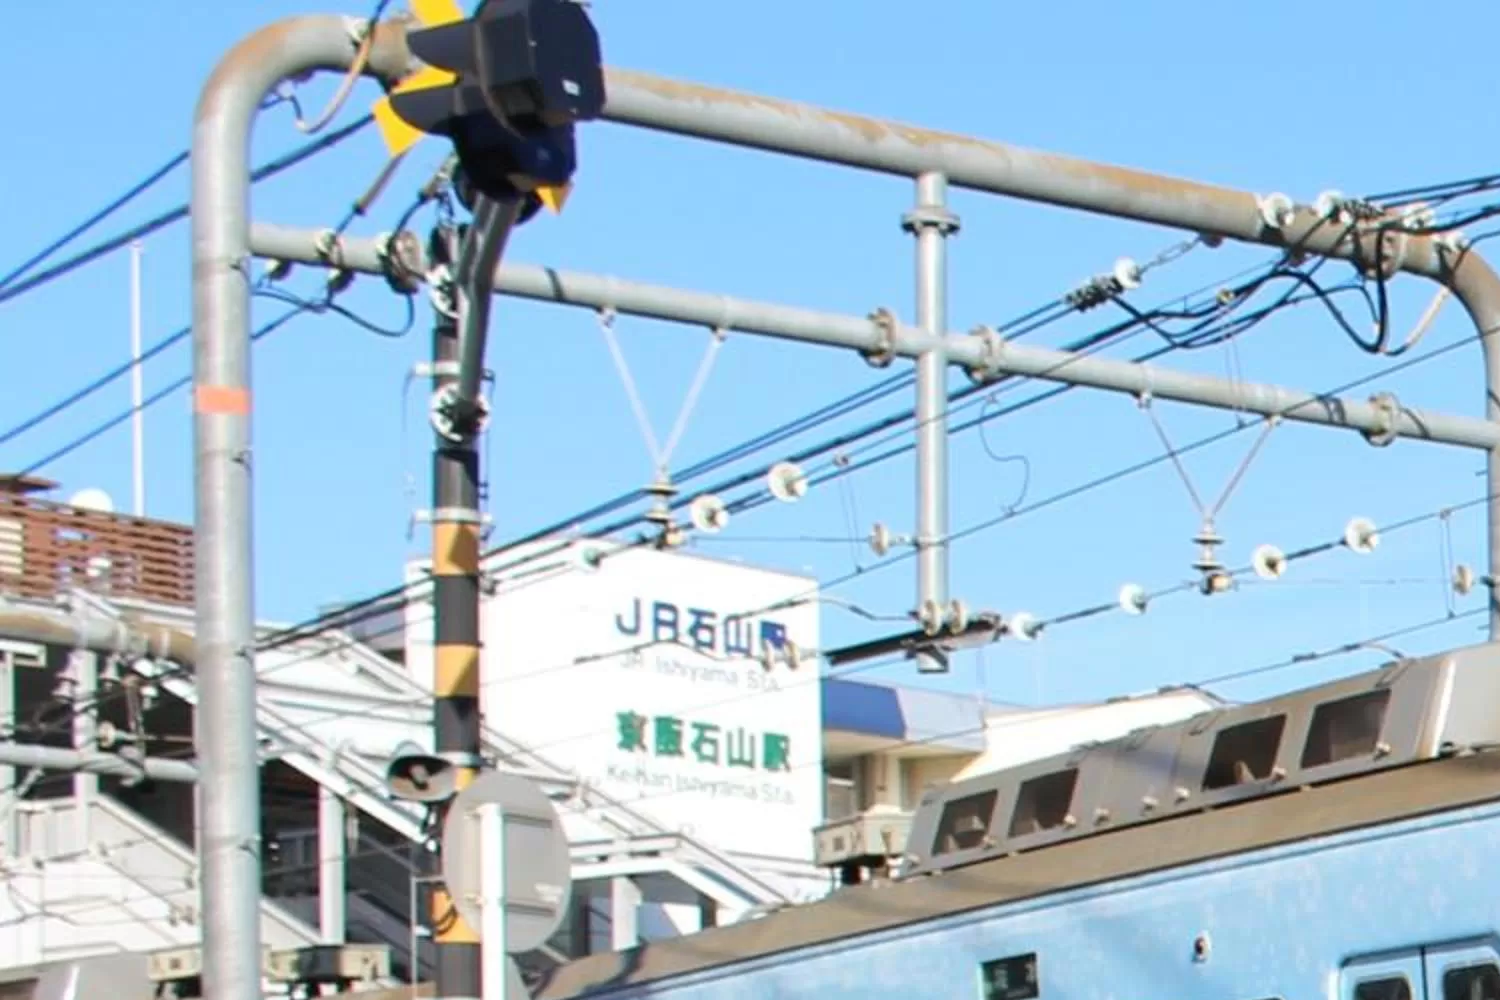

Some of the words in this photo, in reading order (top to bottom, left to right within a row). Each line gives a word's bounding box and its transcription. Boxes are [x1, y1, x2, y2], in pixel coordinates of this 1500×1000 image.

[616, 710, 791, 772] 京阪石山駅
